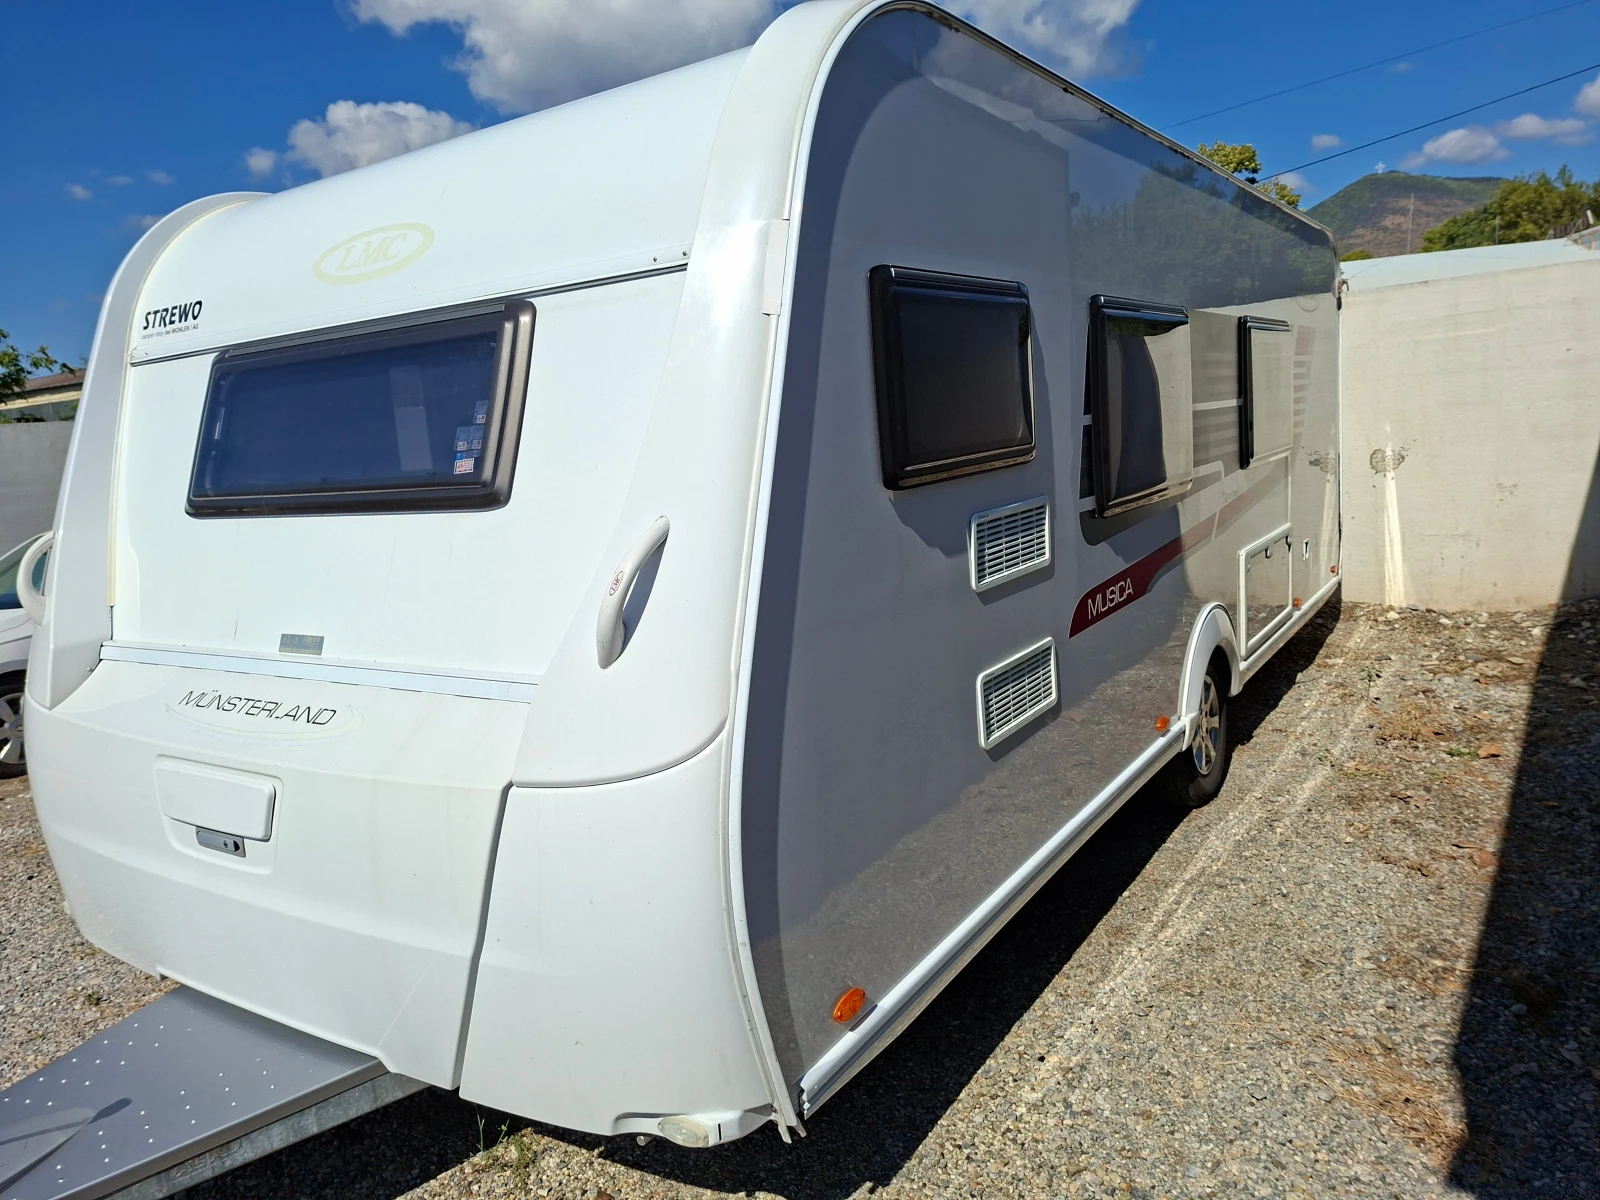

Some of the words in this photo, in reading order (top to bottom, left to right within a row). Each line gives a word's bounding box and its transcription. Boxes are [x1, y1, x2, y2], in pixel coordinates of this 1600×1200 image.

[335, 233, 408, 272] LMC
[143, 300, 203, 330] STREWO
[171, 326, 190, 334] WOHLEN
[192, 323, 199, 331] AG
[1087, 577, 1134, 620] MUSICA
[178, 689, 337, 726] MÜNSTERLAND
